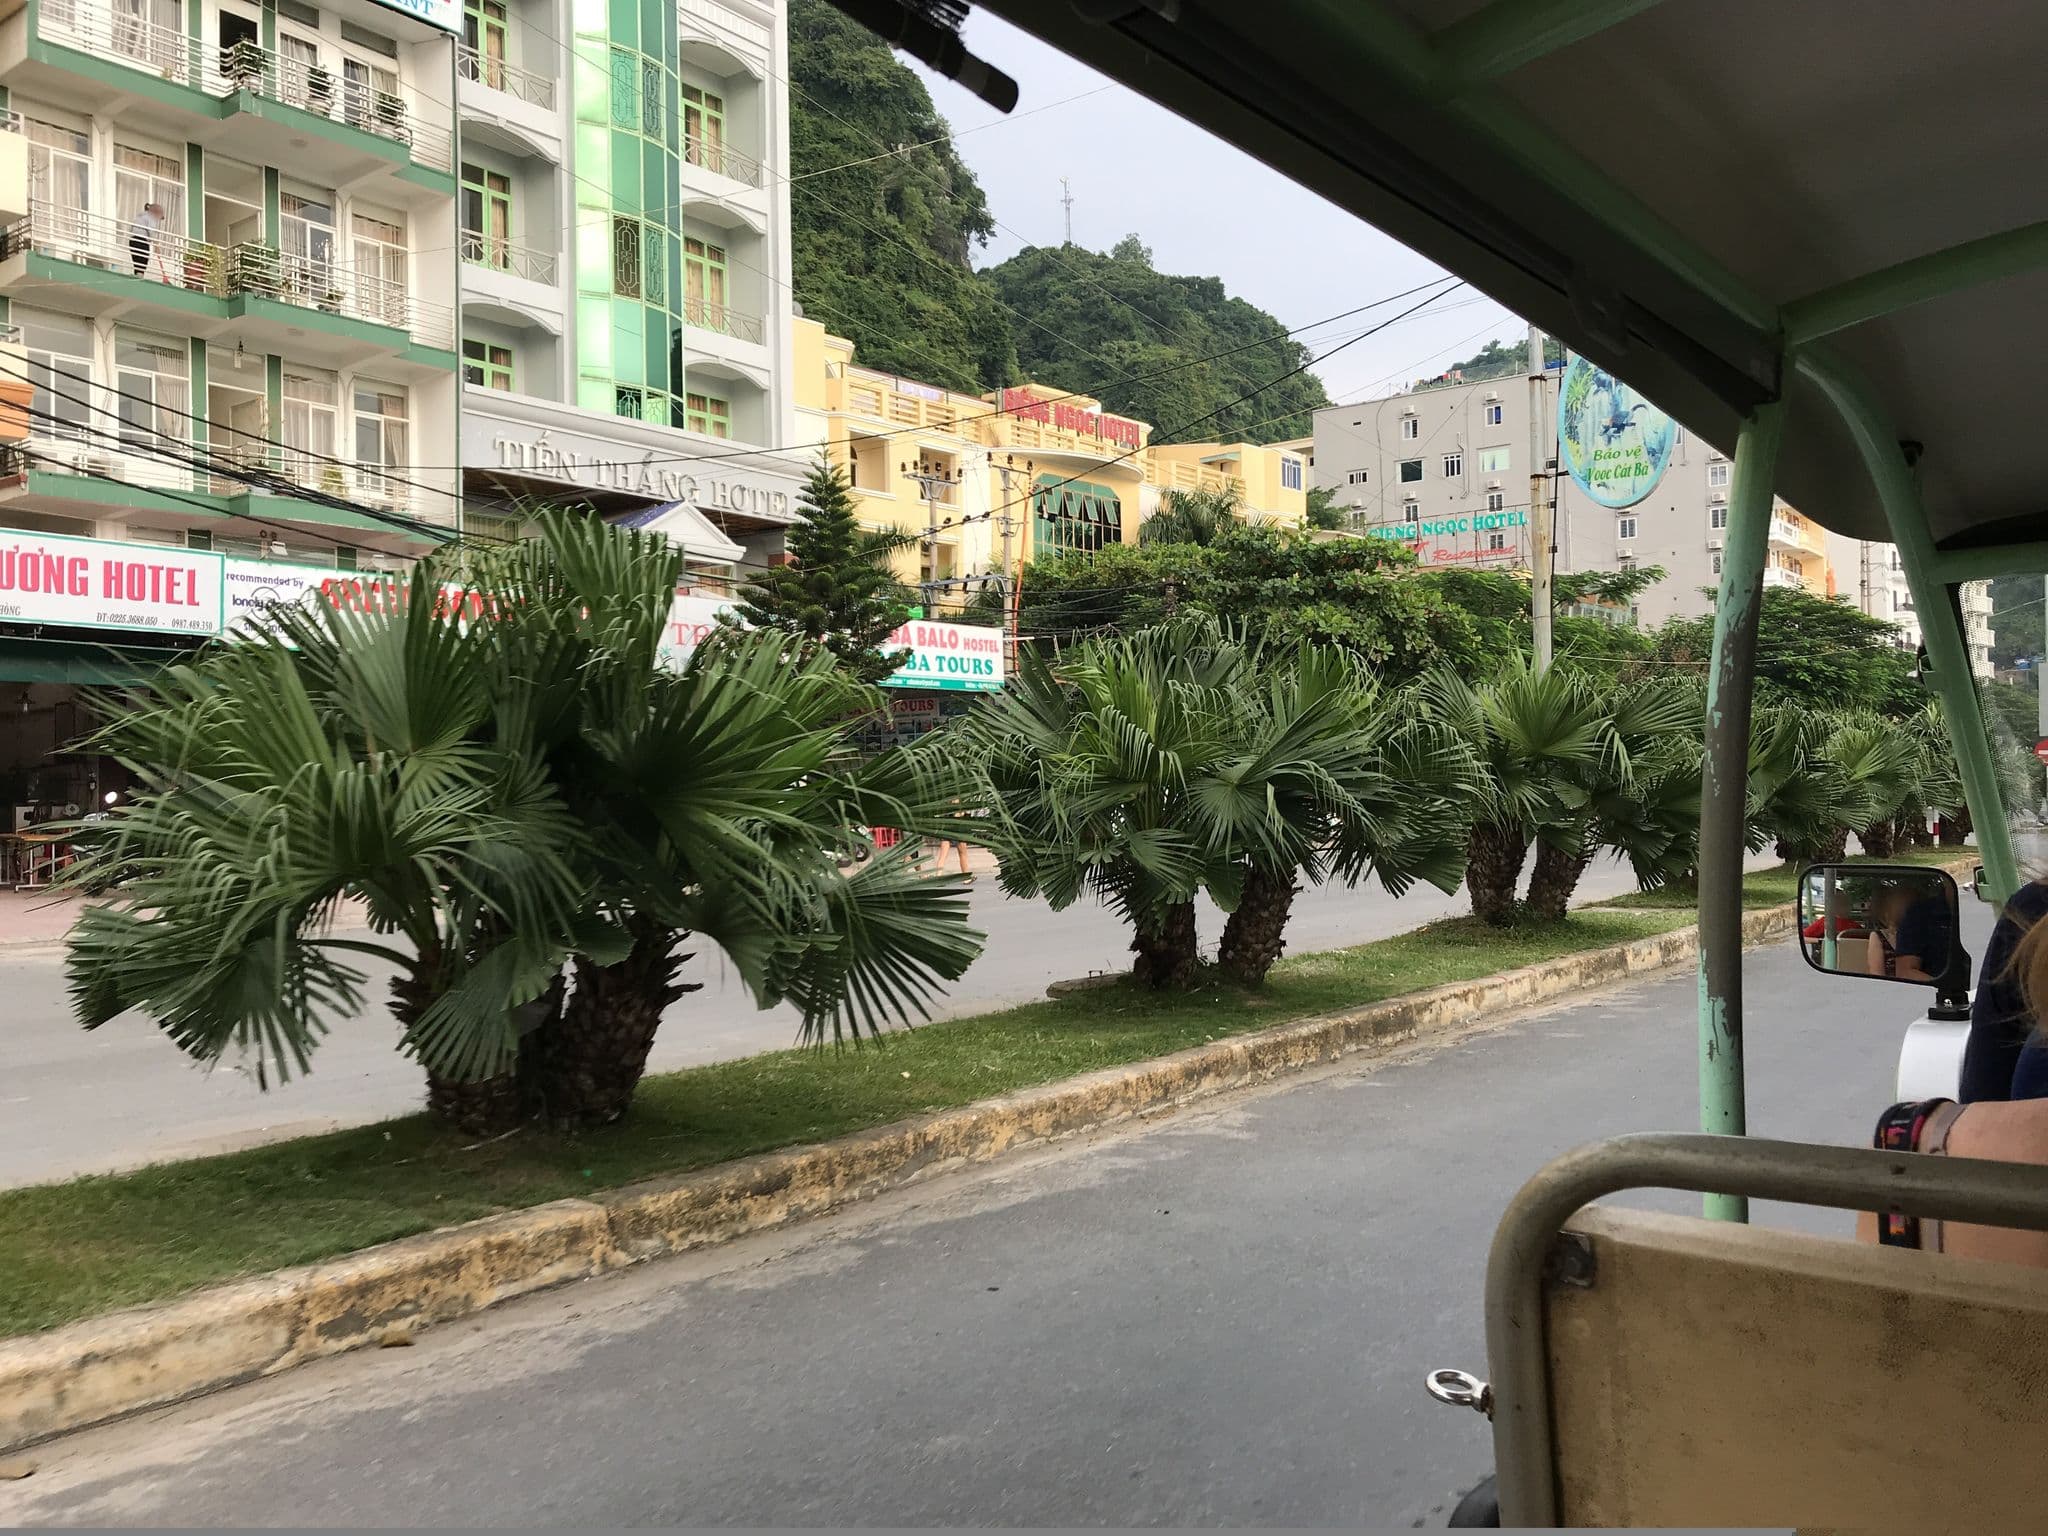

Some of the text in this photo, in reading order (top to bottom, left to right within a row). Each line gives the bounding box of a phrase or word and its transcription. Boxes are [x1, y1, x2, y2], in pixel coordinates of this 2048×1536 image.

[1473, 511, 1530, 532] HOTEL
[103, 560, 200, 607] HOTEL
[226, 572, 304, 588] recommended by
[232, 594, 264, 611] lonely
[917, 626, 959, 649] BALO
[963, 637, 1000, 653] HOSTEL
[935, 655, 994, 675] TOURS
